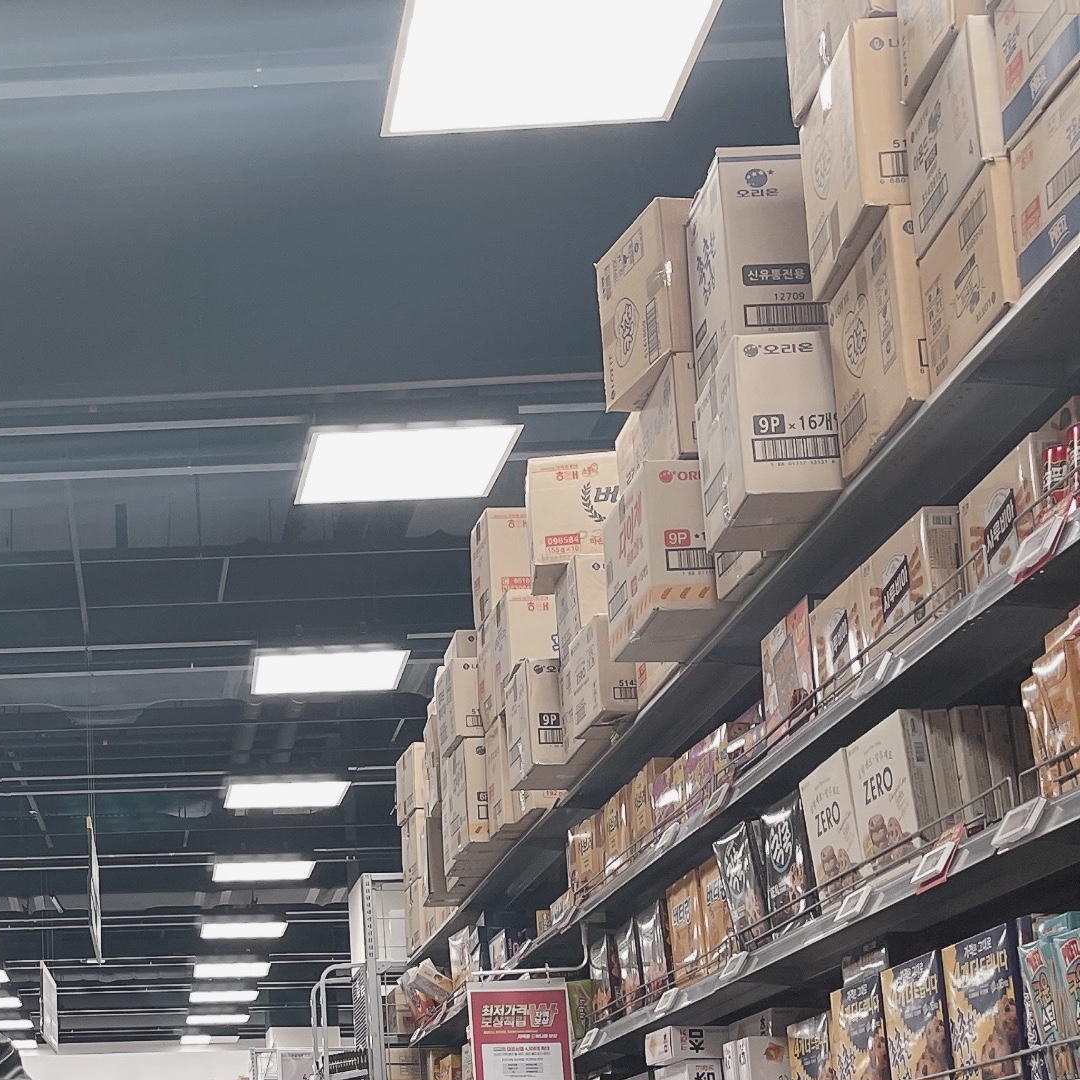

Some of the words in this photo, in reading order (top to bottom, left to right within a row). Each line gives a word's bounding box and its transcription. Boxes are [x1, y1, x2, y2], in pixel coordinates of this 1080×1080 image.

[736, 187, 780, 198] 오리온
[747, 269, 806, 282] 신유통전용
[773, 292, 805, 301] 12709
[763, 343, 814, 355] 오리온
[758, 416, 780, 433] 9P
[799, 413, 839, 431] 16개
[593, 485, 620, 503] 버
[668, 532, 688, 545] 9P
[542, 714, 557, 726] 9P
[863, 767, 893, 806] ZERO
[814, 801, 841, 838] ZERO
